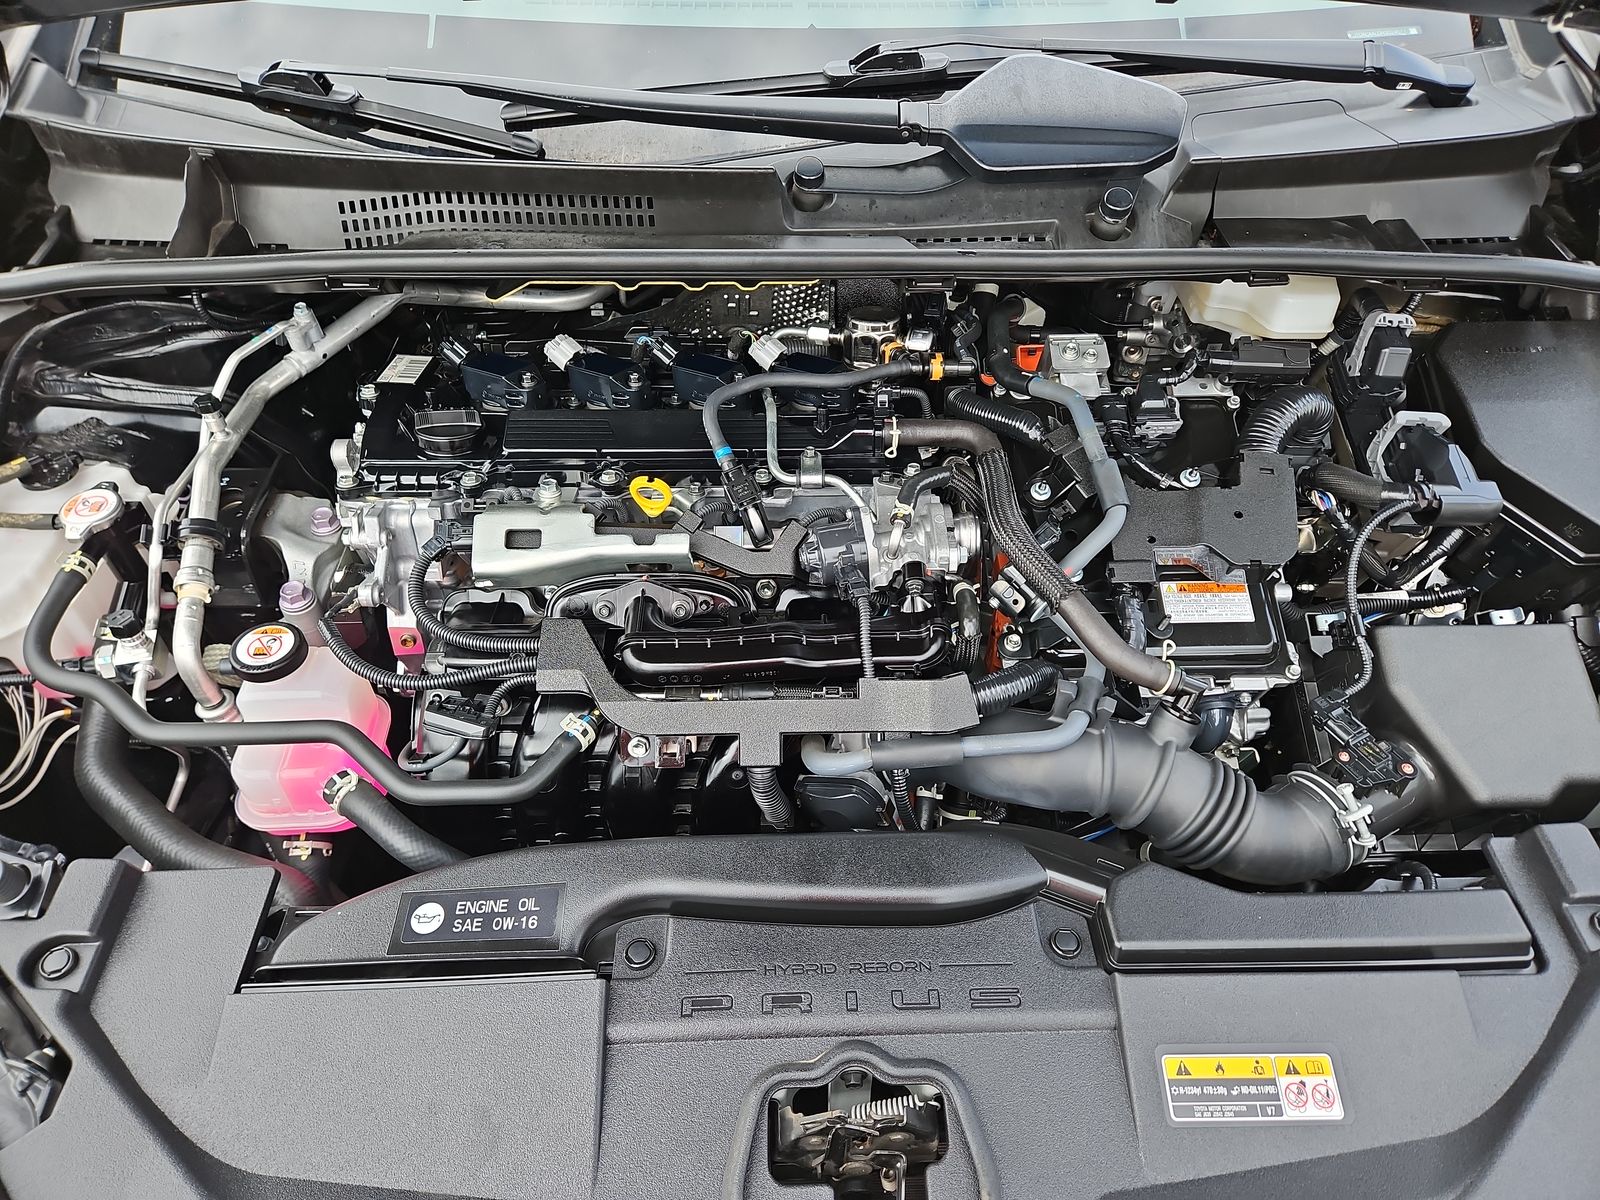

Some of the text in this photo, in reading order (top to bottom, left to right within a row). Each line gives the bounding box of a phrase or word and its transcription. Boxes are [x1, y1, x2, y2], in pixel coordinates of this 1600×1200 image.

[455, 897, 540, 914] ENGINE OIL
[452, 915, 538, 932] SAE 0W-16
[763, 961, 932, 976] HYBRID REBORN
[681, 987, 1022, 1018] PRIUS
